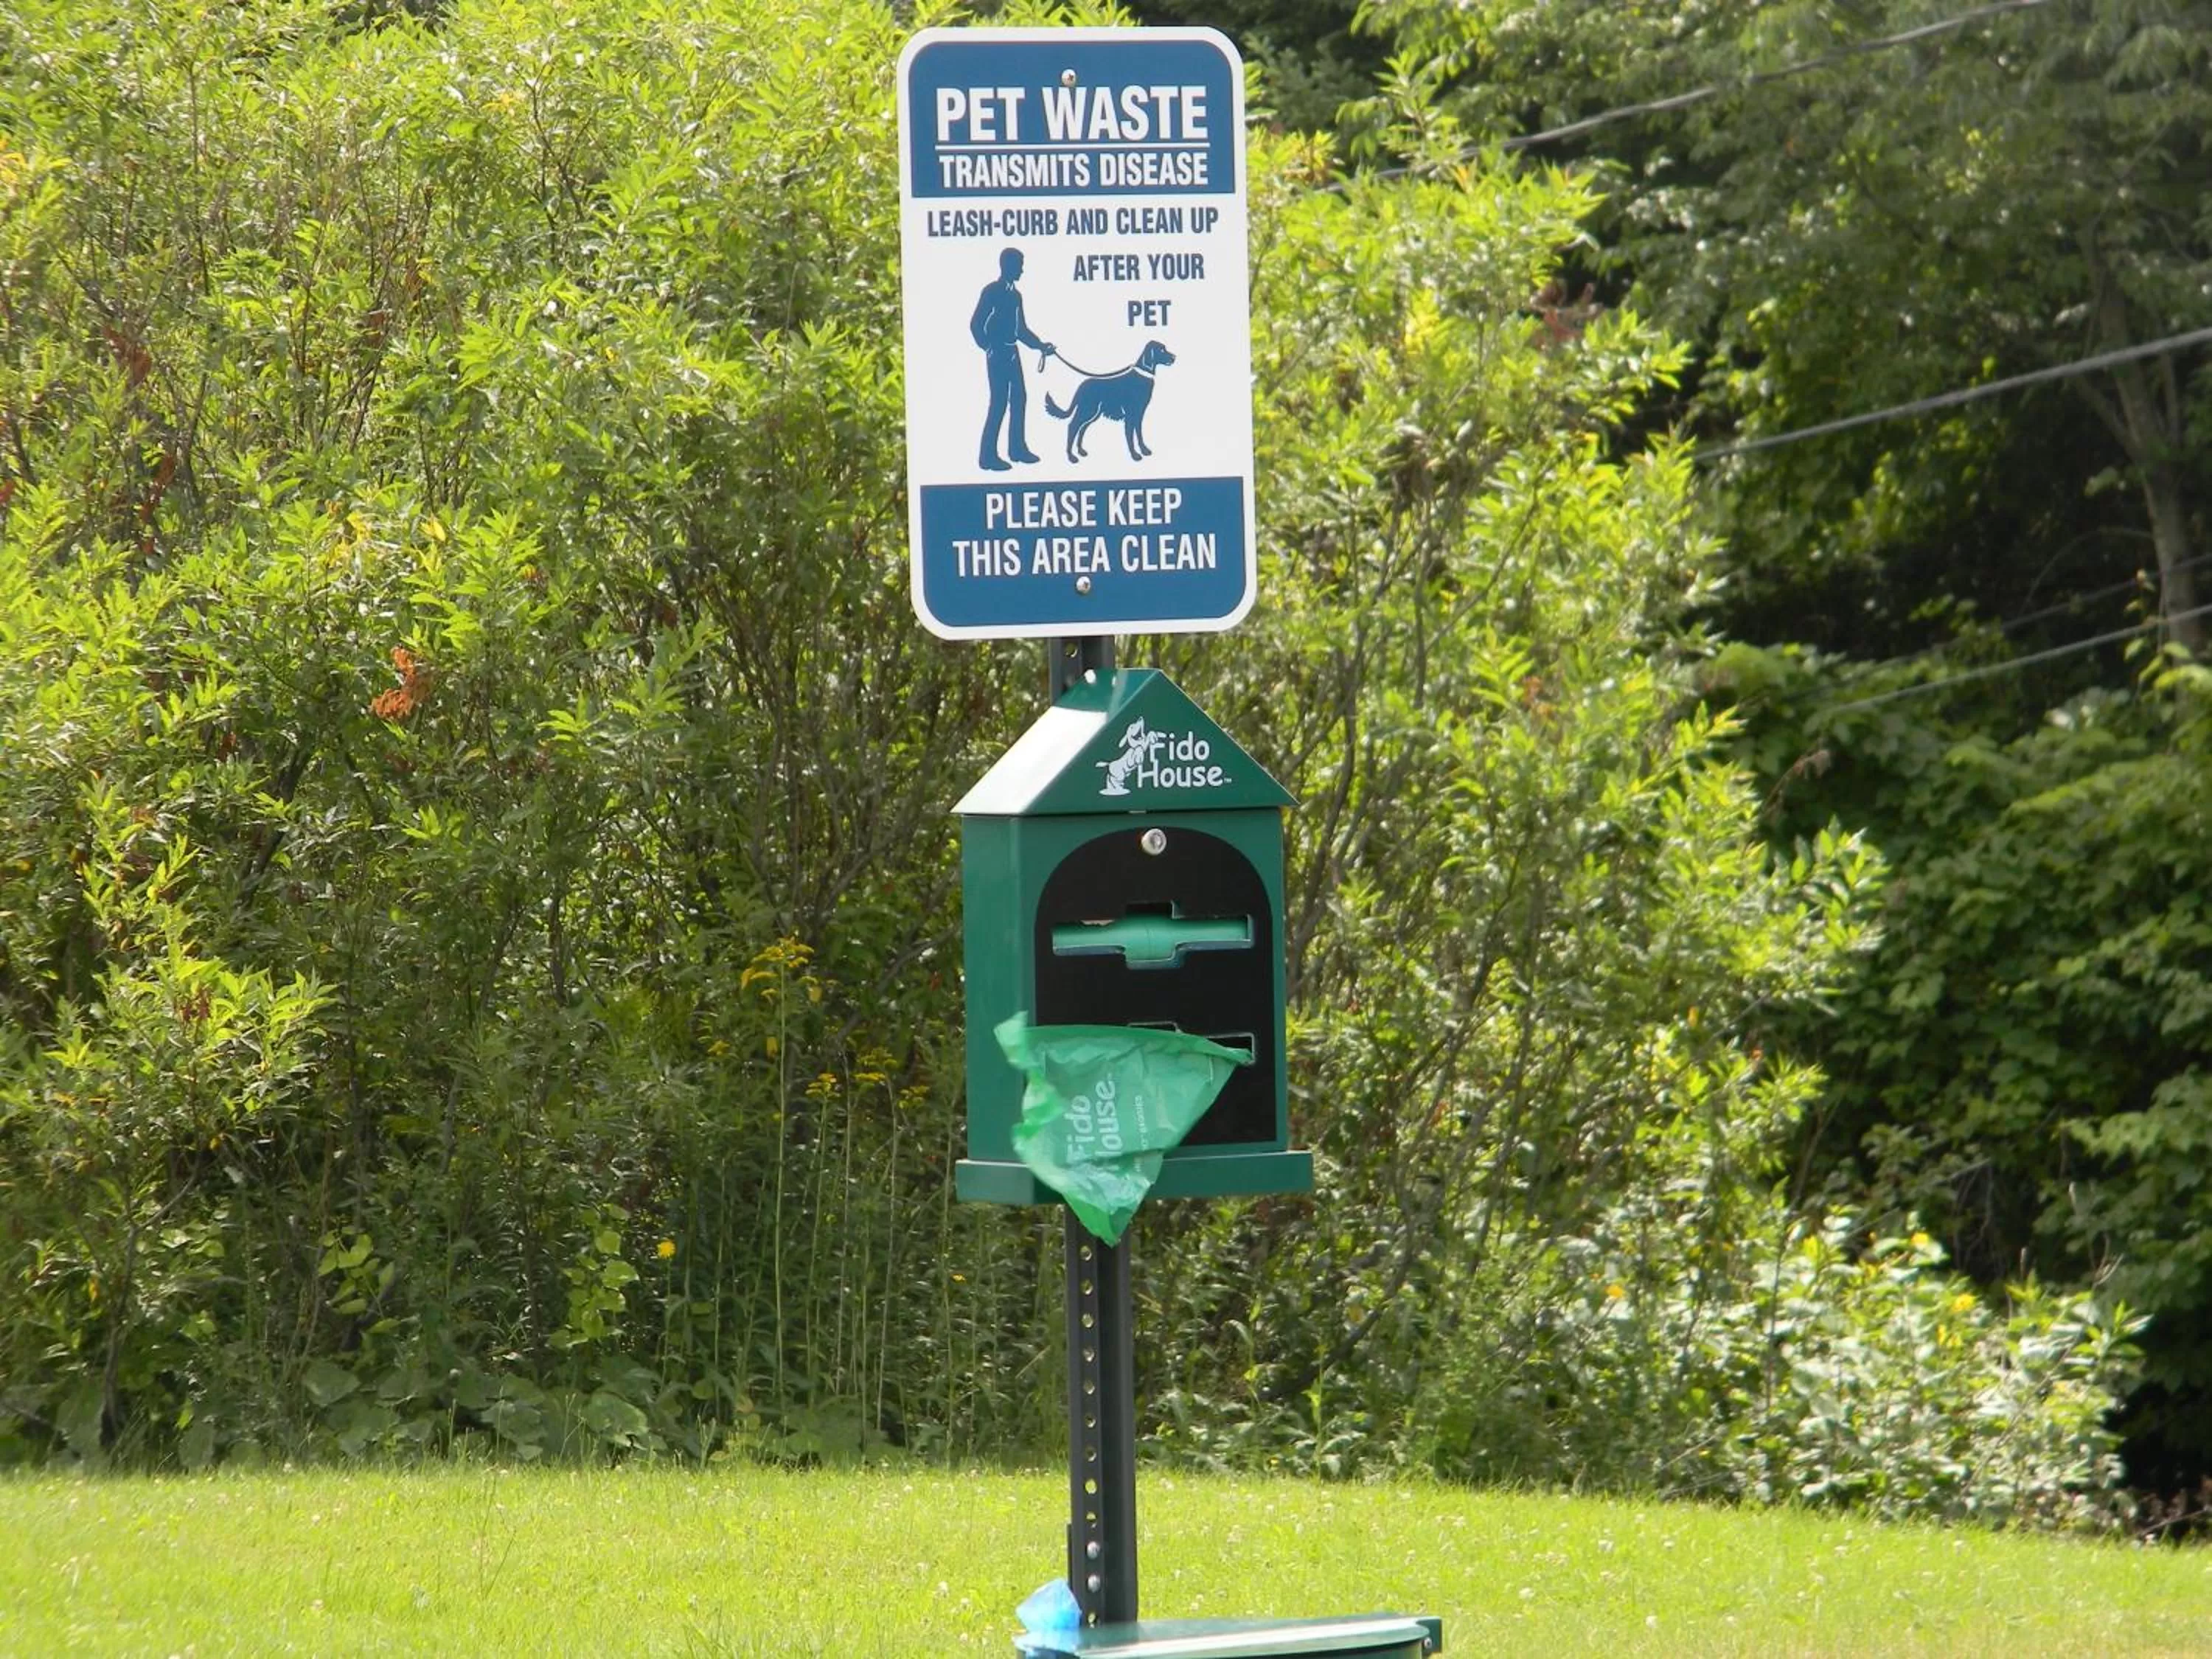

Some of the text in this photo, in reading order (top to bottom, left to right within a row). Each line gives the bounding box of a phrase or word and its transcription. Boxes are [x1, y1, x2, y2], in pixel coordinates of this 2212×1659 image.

[936, 85, 1208, 142] PET WASTE
[939, 152, 1208, 188] TRANSMITS DISEASE
[928, 206, 1219, 237] LEASH-CURB AND CLEAN UP
[1074, 253, 1205, 281] AFTER YOUR
[1127, 300, 1172, 327] PET
[986, 487, 1182, 529] PLEASE KEEP
[953, 533, 1216, 577] THIS AREA CLEAN
[1150, 731, 1210, 762] Fido
[1137, 759, 1223, 788] House
